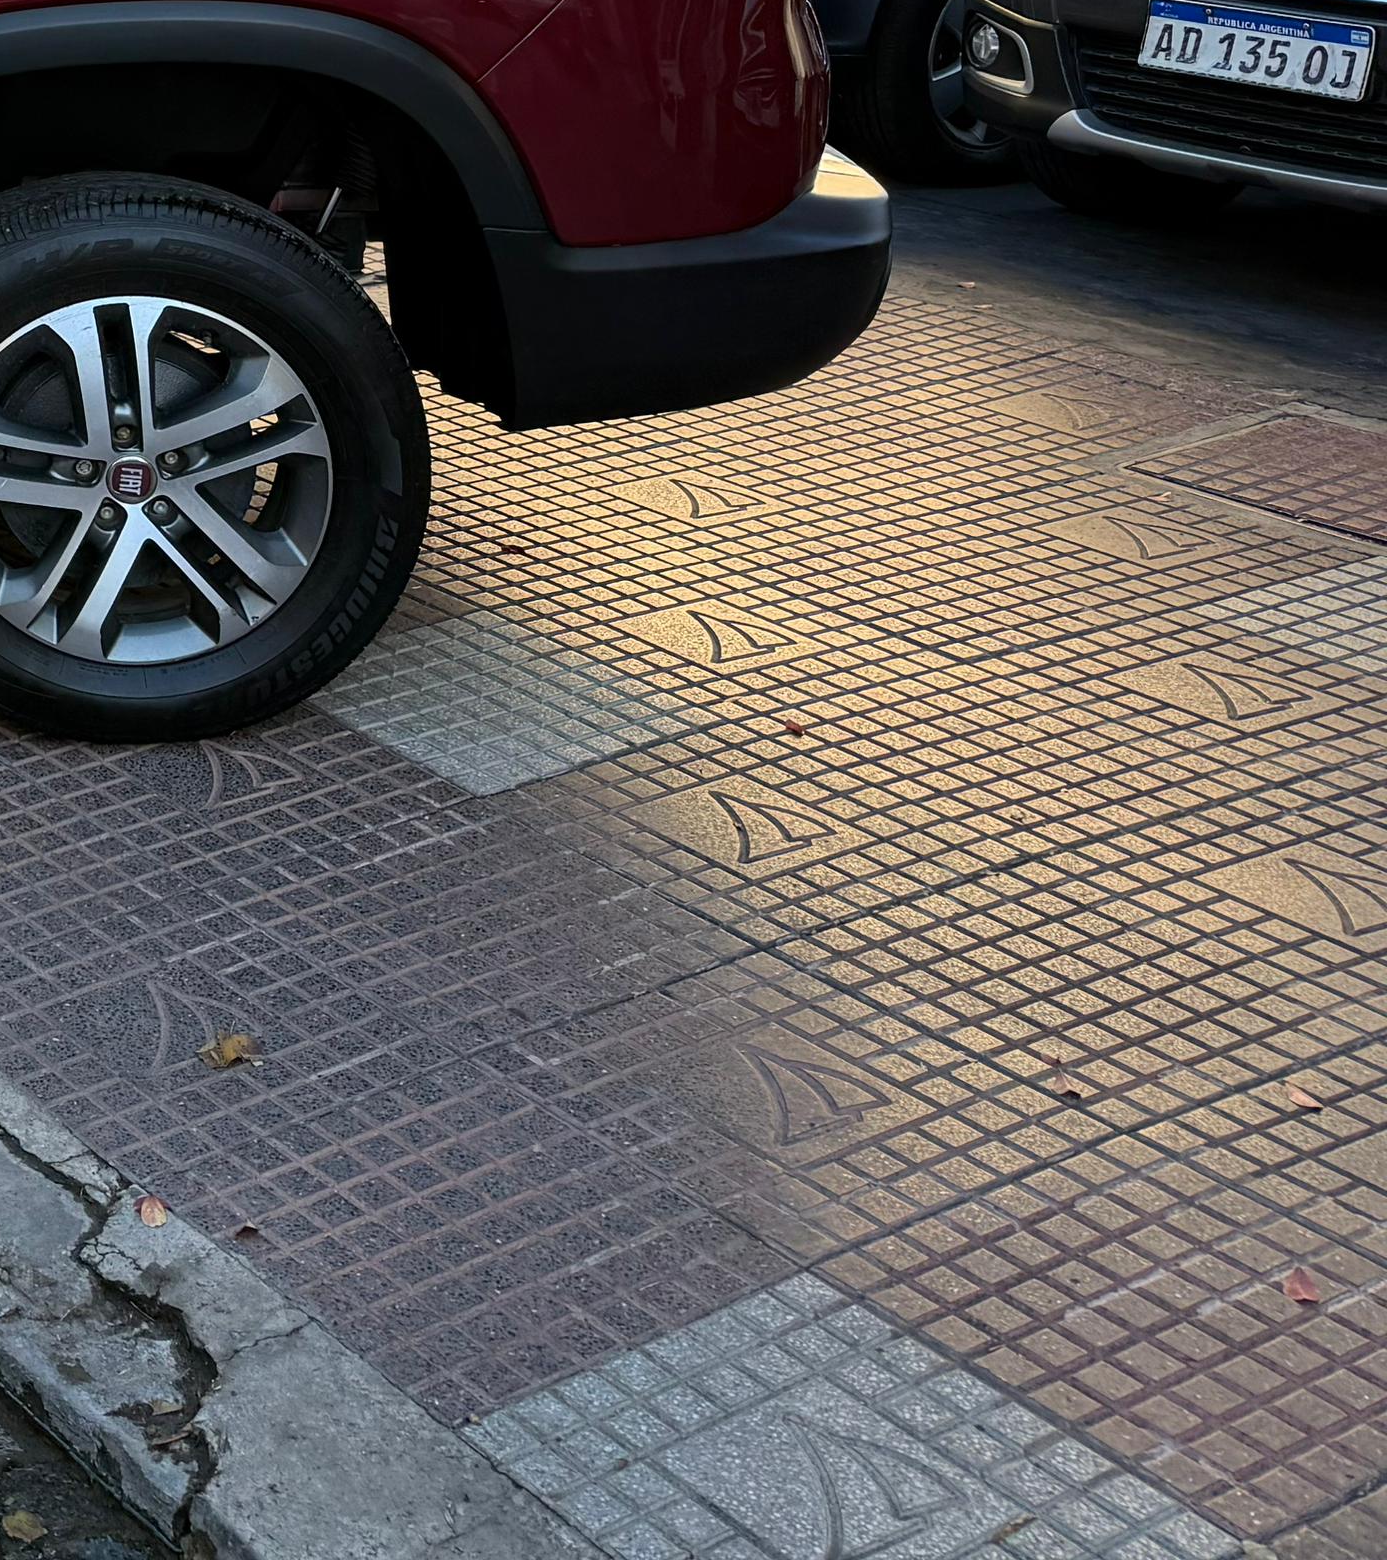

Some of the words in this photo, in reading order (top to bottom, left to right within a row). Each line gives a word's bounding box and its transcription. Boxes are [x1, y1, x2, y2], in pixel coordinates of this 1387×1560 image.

[1258, 23, 1310, 39] ARGENTINA
[1151, 23, 1203, 65] AD
[1213, 32, 1291, 79] 135
[119, 467, 143, 496] FIAT
